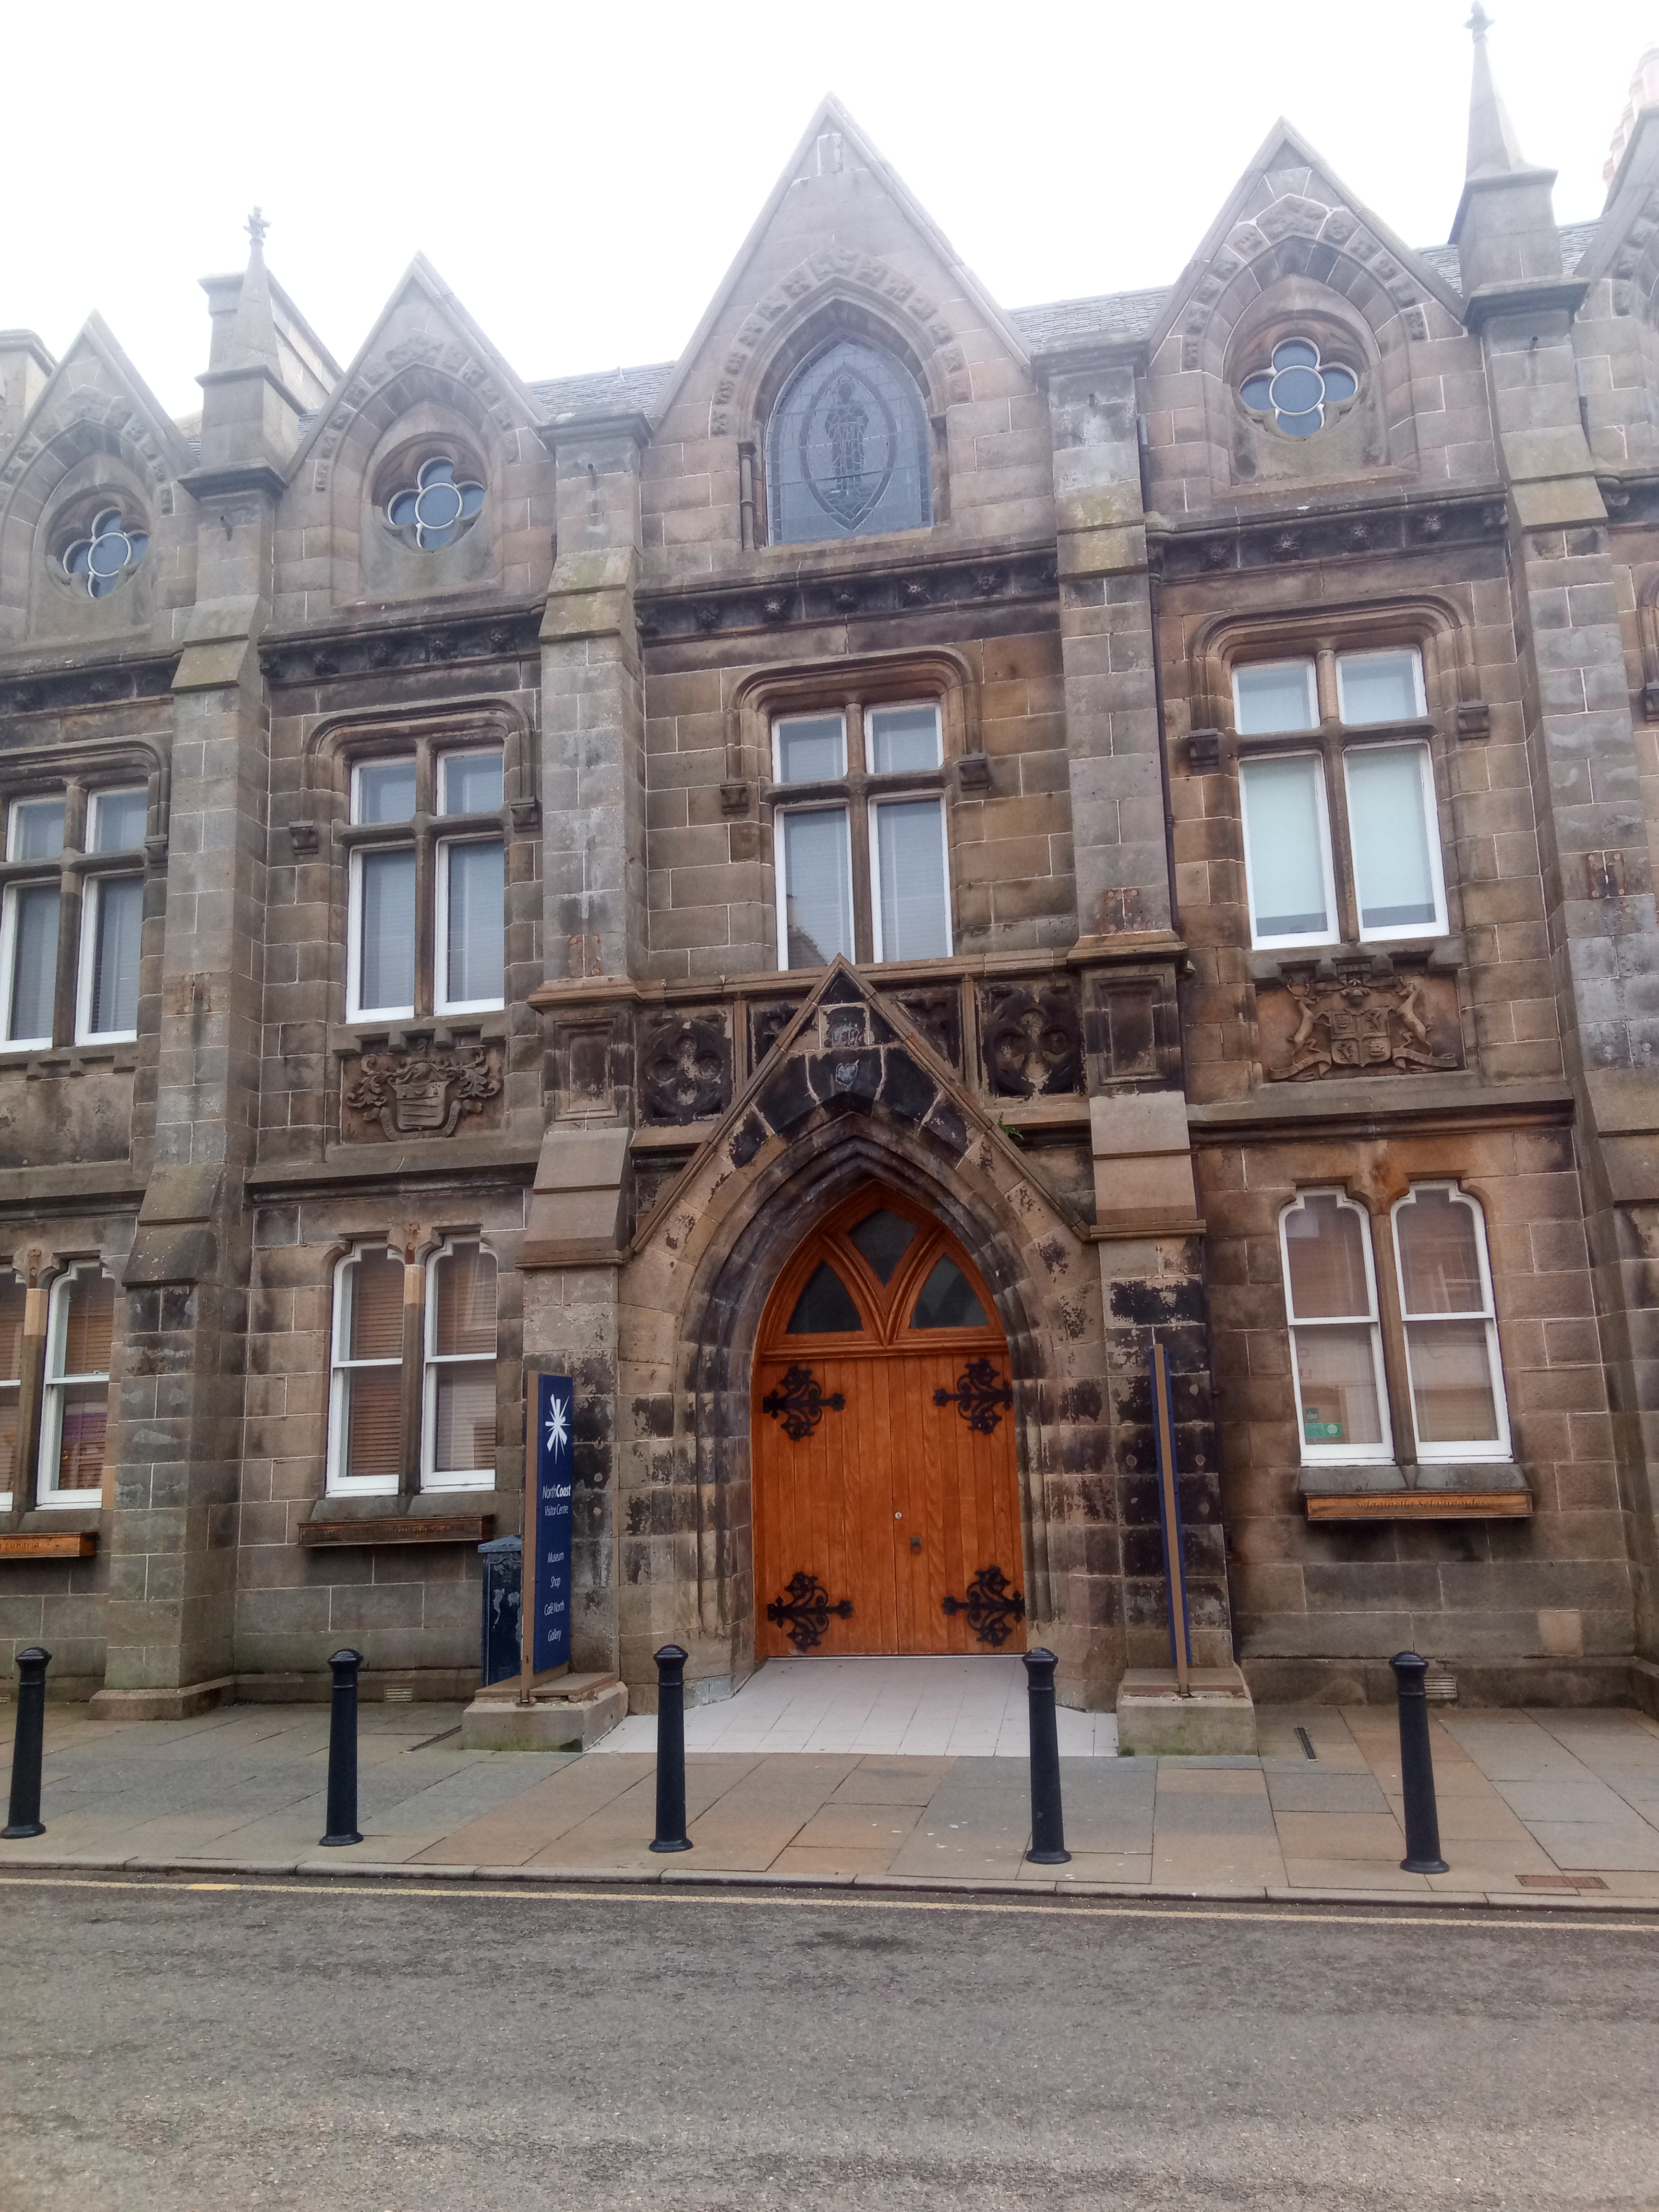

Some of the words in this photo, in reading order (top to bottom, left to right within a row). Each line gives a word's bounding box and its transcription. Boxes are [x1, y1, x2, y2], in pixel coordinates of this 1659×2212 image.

[544, 1505, 556, 1516] Visitor
[556, 1503, 569, 1515] Centre
[547, 1551, 565, 1563] Museum
[550, 1575, 561, 1588] Shop
[553, 1599, 565, 1613] North
[548, 1628, 562, 1642] Gallery
